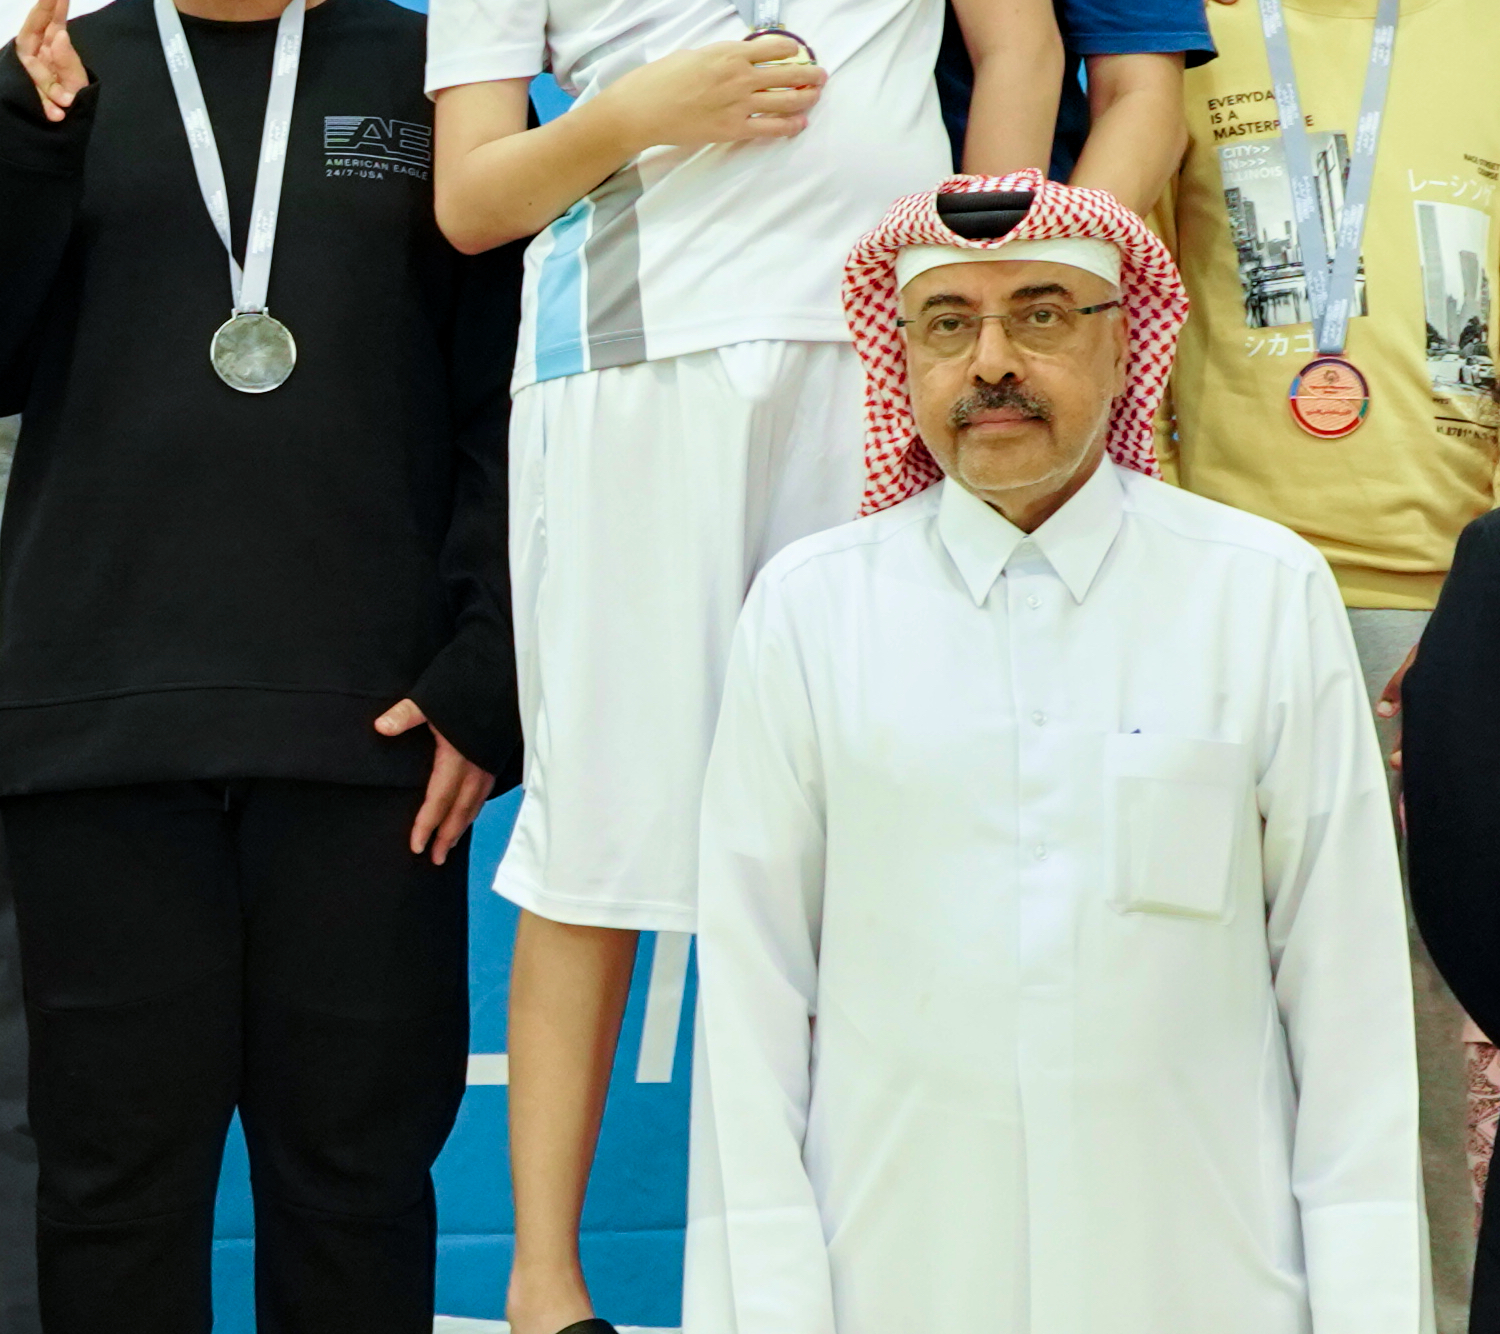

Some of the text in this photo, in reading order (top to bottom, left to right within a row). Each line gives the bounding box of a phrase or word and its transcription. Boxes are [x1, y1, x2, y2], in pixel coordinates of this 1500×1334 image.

[1207, 89, 1276, 111] EVERYDA
[1210, 109, 1239, 125] IS A
[1213, 114, 1315, 142] MASTERPE
[325, 158, 429, 181] AMERICAN EAGLE
[325, 169, 384, 180] 24/7-USA
